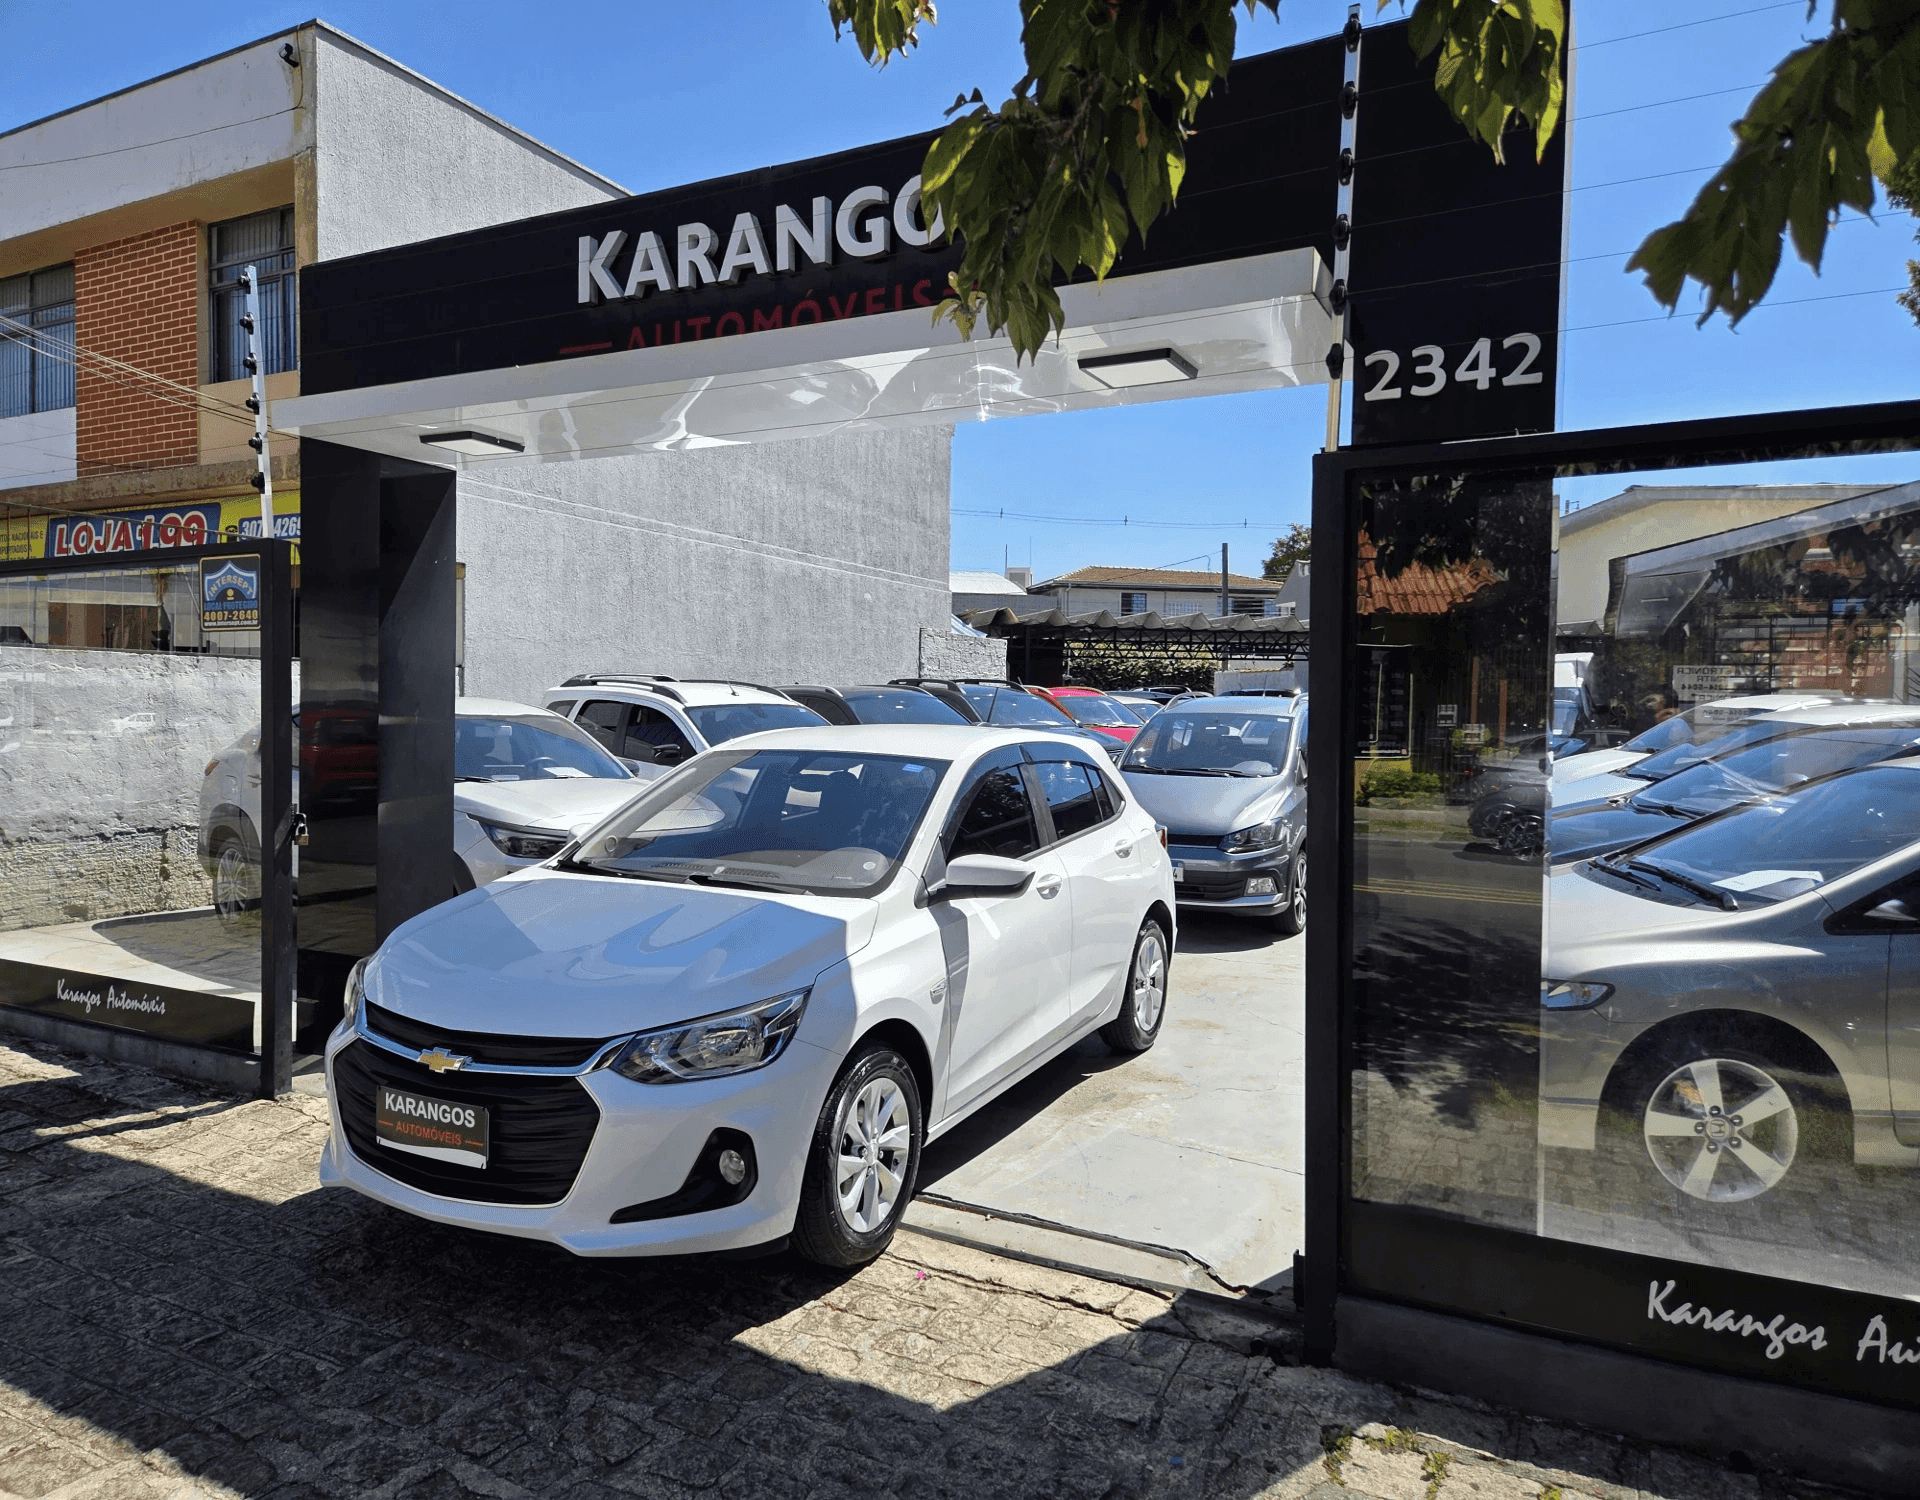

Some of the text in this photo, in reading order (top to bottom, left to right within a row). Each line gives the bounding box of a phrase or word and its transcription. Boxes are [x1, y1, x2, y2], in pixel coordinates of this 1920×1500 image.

[578, 174, 947, 305] KARANGO
[1364, 332, 1543, 401] 2342
[54, 519, 135, 557] LOJA
[208, 575, 254, 597] INTERSEPT
[204, 609, 258, 621] 4007-2640
[57, 978, 166, 1015] Karangos Automóveis
[385, 1092, 475, 1128] KARANGOS
[395, 1121, 462, 1145] AUTOMÓVEIS
[1647, 1279, 1920, 1364] Karangos Au
